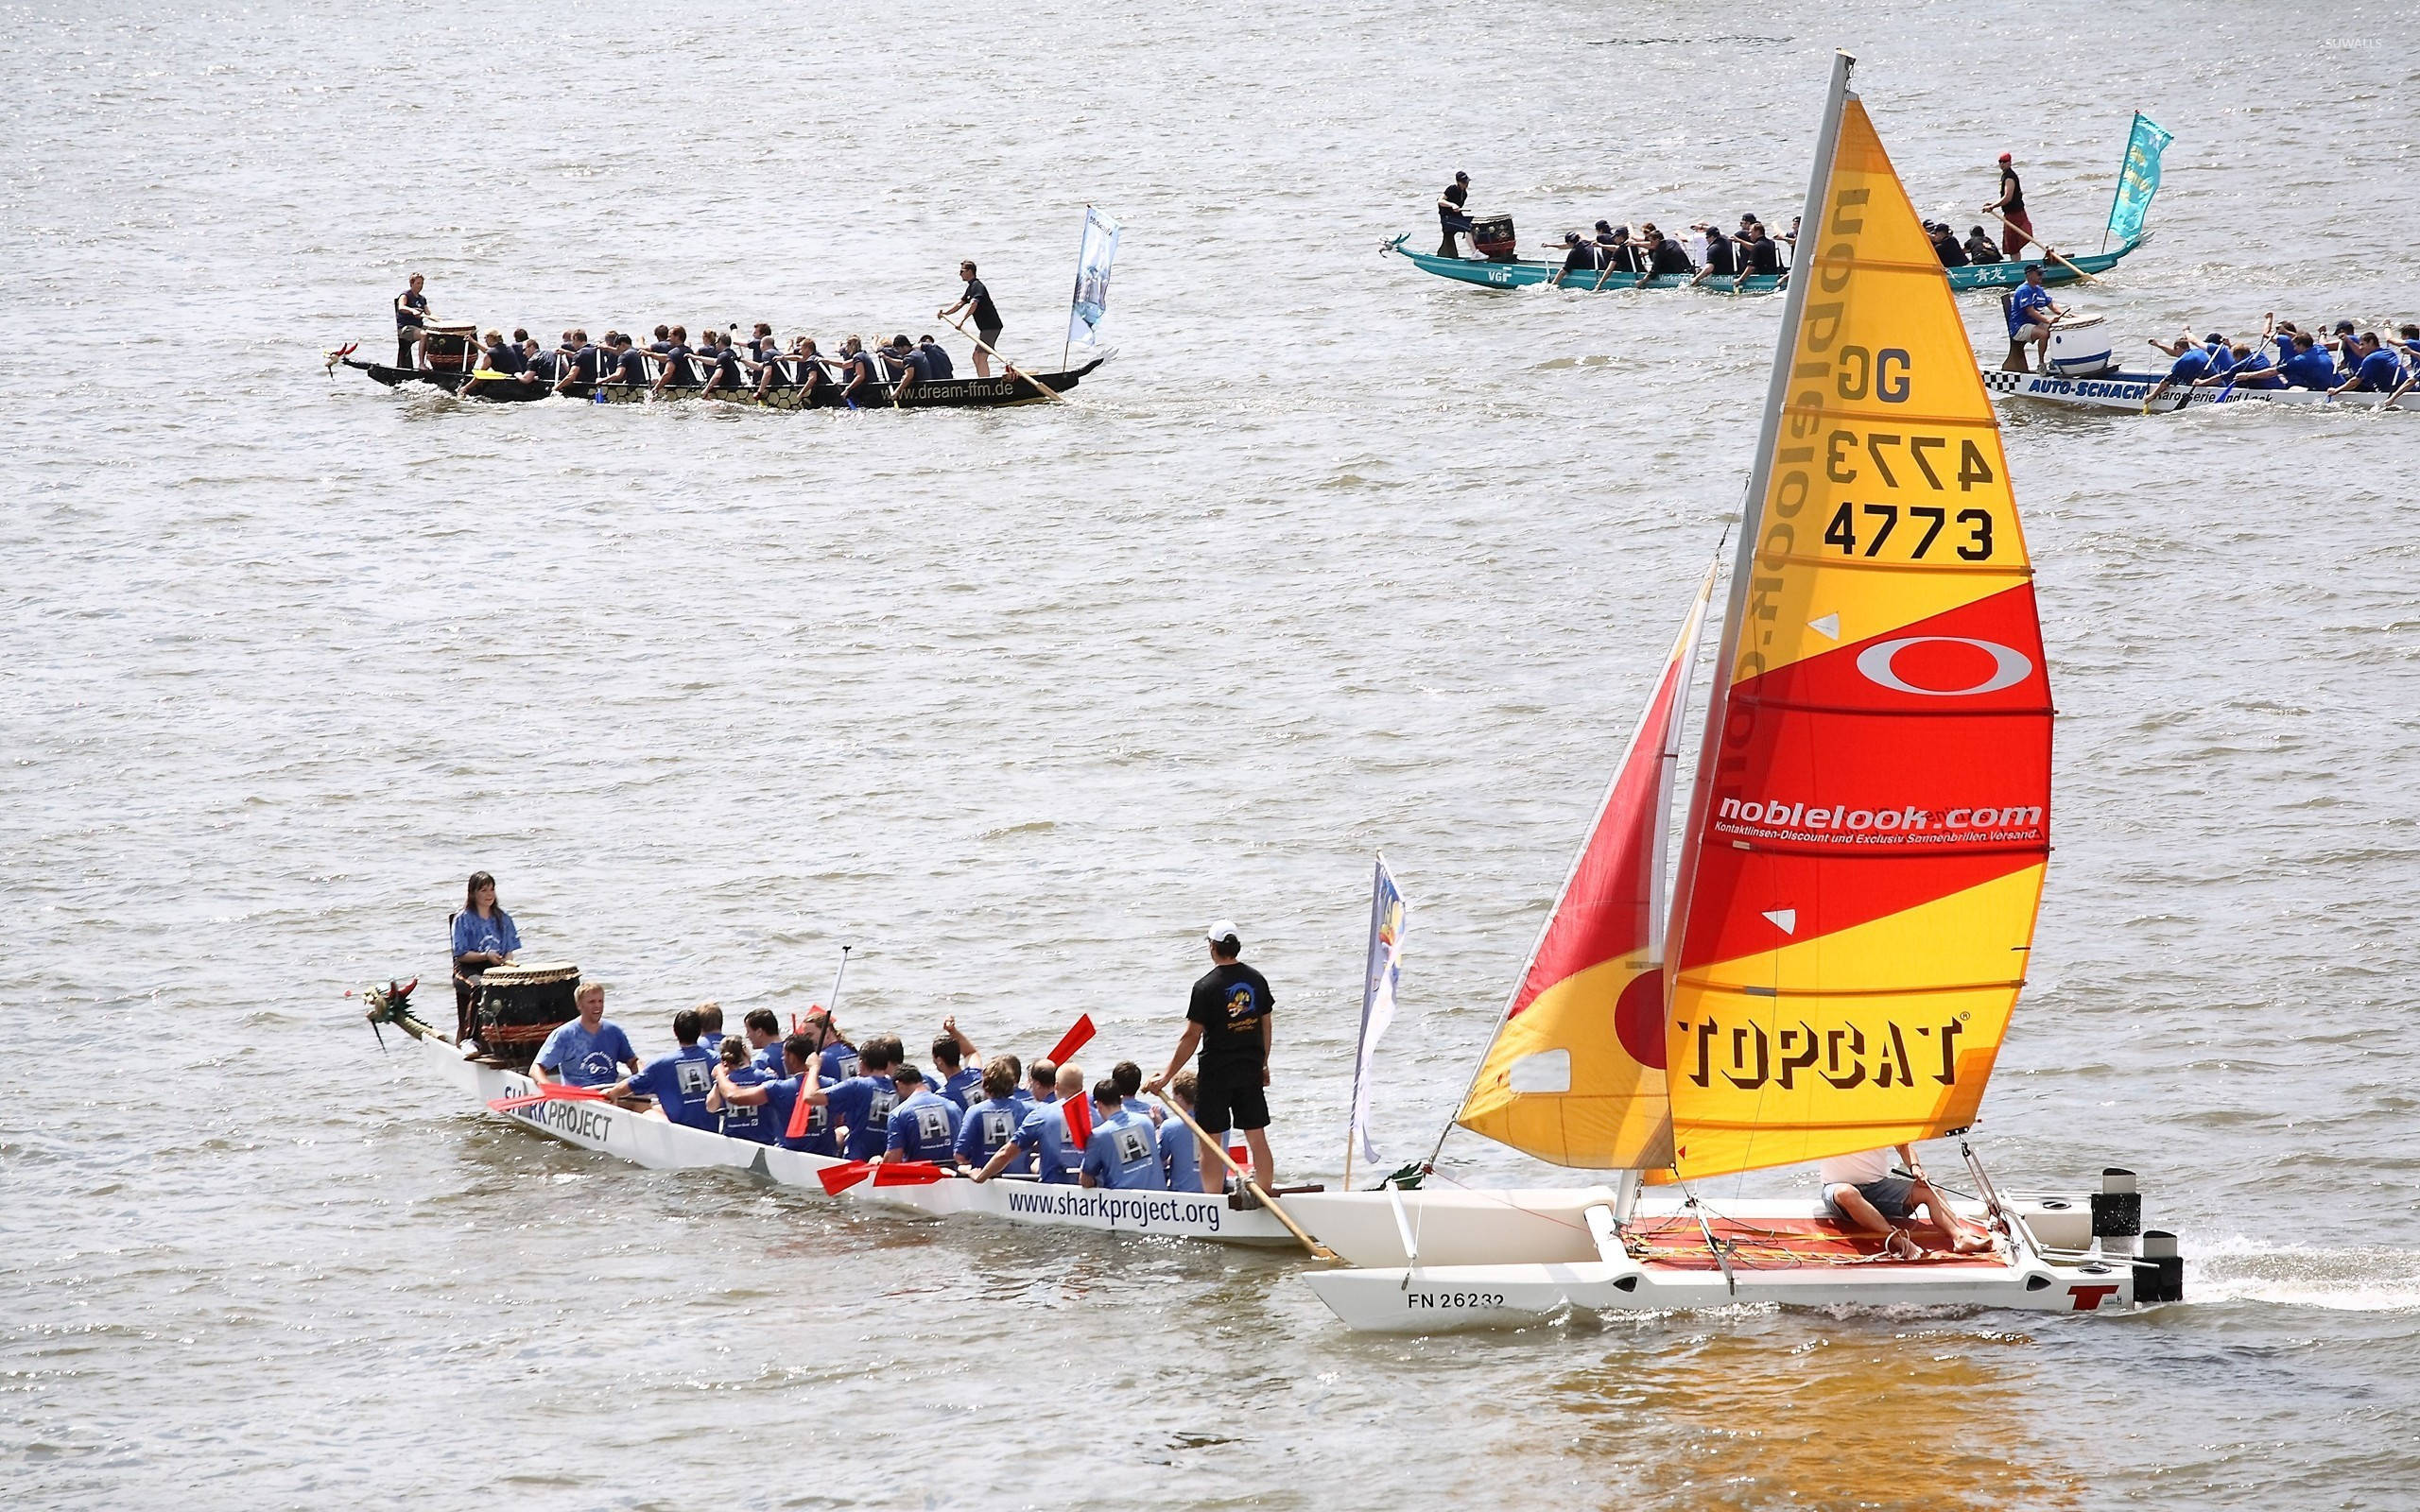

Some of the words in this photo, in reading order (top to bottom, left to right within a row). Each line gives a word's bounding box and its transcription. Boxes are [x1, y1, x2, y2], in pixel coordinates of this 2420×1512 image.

[1488, 266, 1512, 283] VGF
[2028, 378, 2149, 401] AUTO-SCHACH
[1824, 501, 1994, 561] 4773
[1718, 796, 2043, 831] noblelook.com
[1832, 833, 1853, 844] und
[1856, 833, 1904, 845] Exclusiv
[1008, 1191, 1220, 1232] www.sharkproject.org
[1408, 1293, 1435, 1308] FN
[1439, 1292, 1505, 1309] 26232
